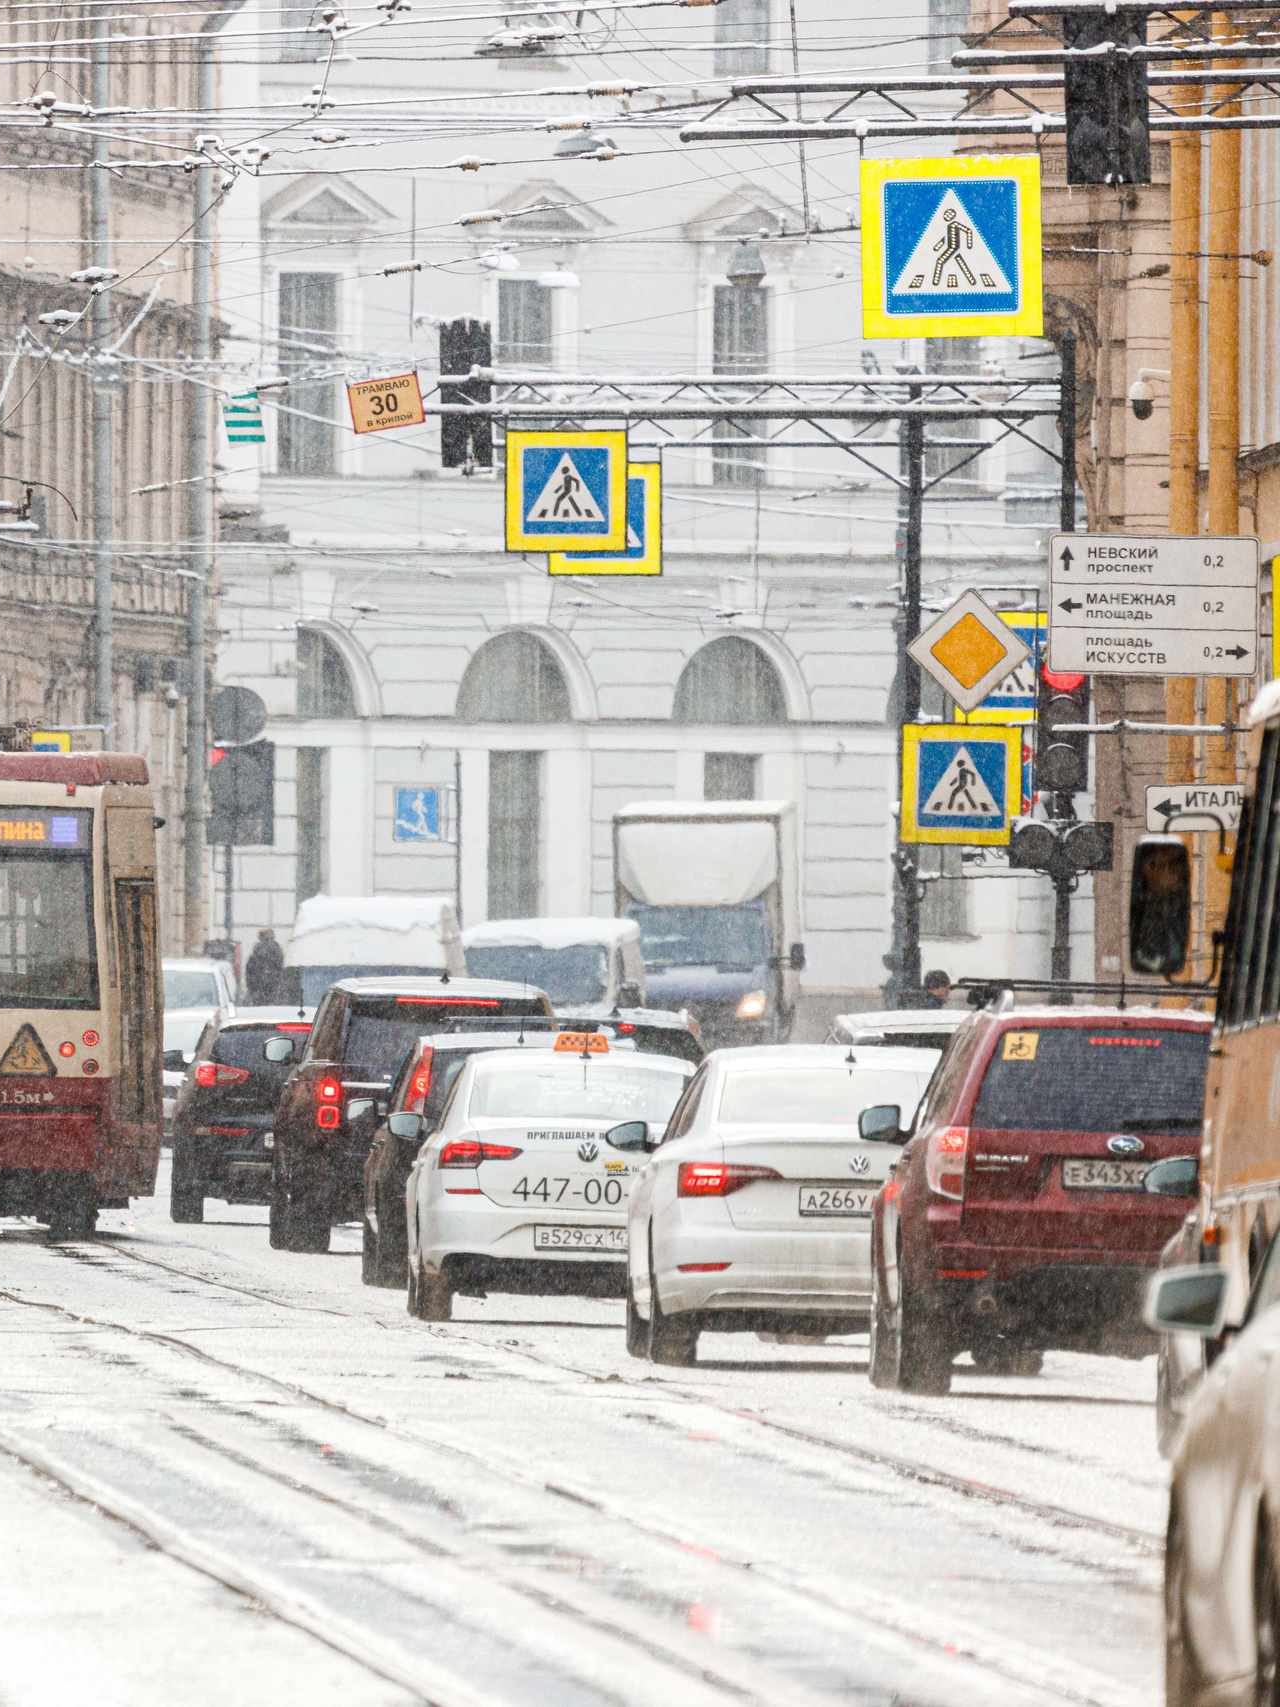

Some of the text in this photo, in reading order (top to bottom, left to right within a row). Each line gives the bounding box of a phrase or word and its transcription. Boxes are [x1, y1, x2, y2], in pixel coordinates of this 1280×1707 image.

[356, 380, 410, 395] ТРАМВАЮ
[370, 393, 398, 415] 30
[376, 411, 413, 426] кривой
[1087, 546, 1158, 559] НЕВСКИЙ
[1203, 555, 1224, 568] 0,2
[1087, 563, 1153, 574] проспект
[1086, 593, 1176, 606] МАНЕЖНАЯ
[1086, 609, 1153, 620] площадь
[1203, 602, 1224, 614] 0,2
[1086, 637, 1153, 648] площадь
[1086, 651, 1167, 664] ИСКУССТВ
[1203, 646, 1223, 659] 0,2
[1, 1090, 40, 1104] 1.5м
[527, 1131, 595, 1141] ПРИГЛАШАЕМ
[807, 1190, 875, 1209] А266У
[541, 1229, 604, 1246] В529СХ
